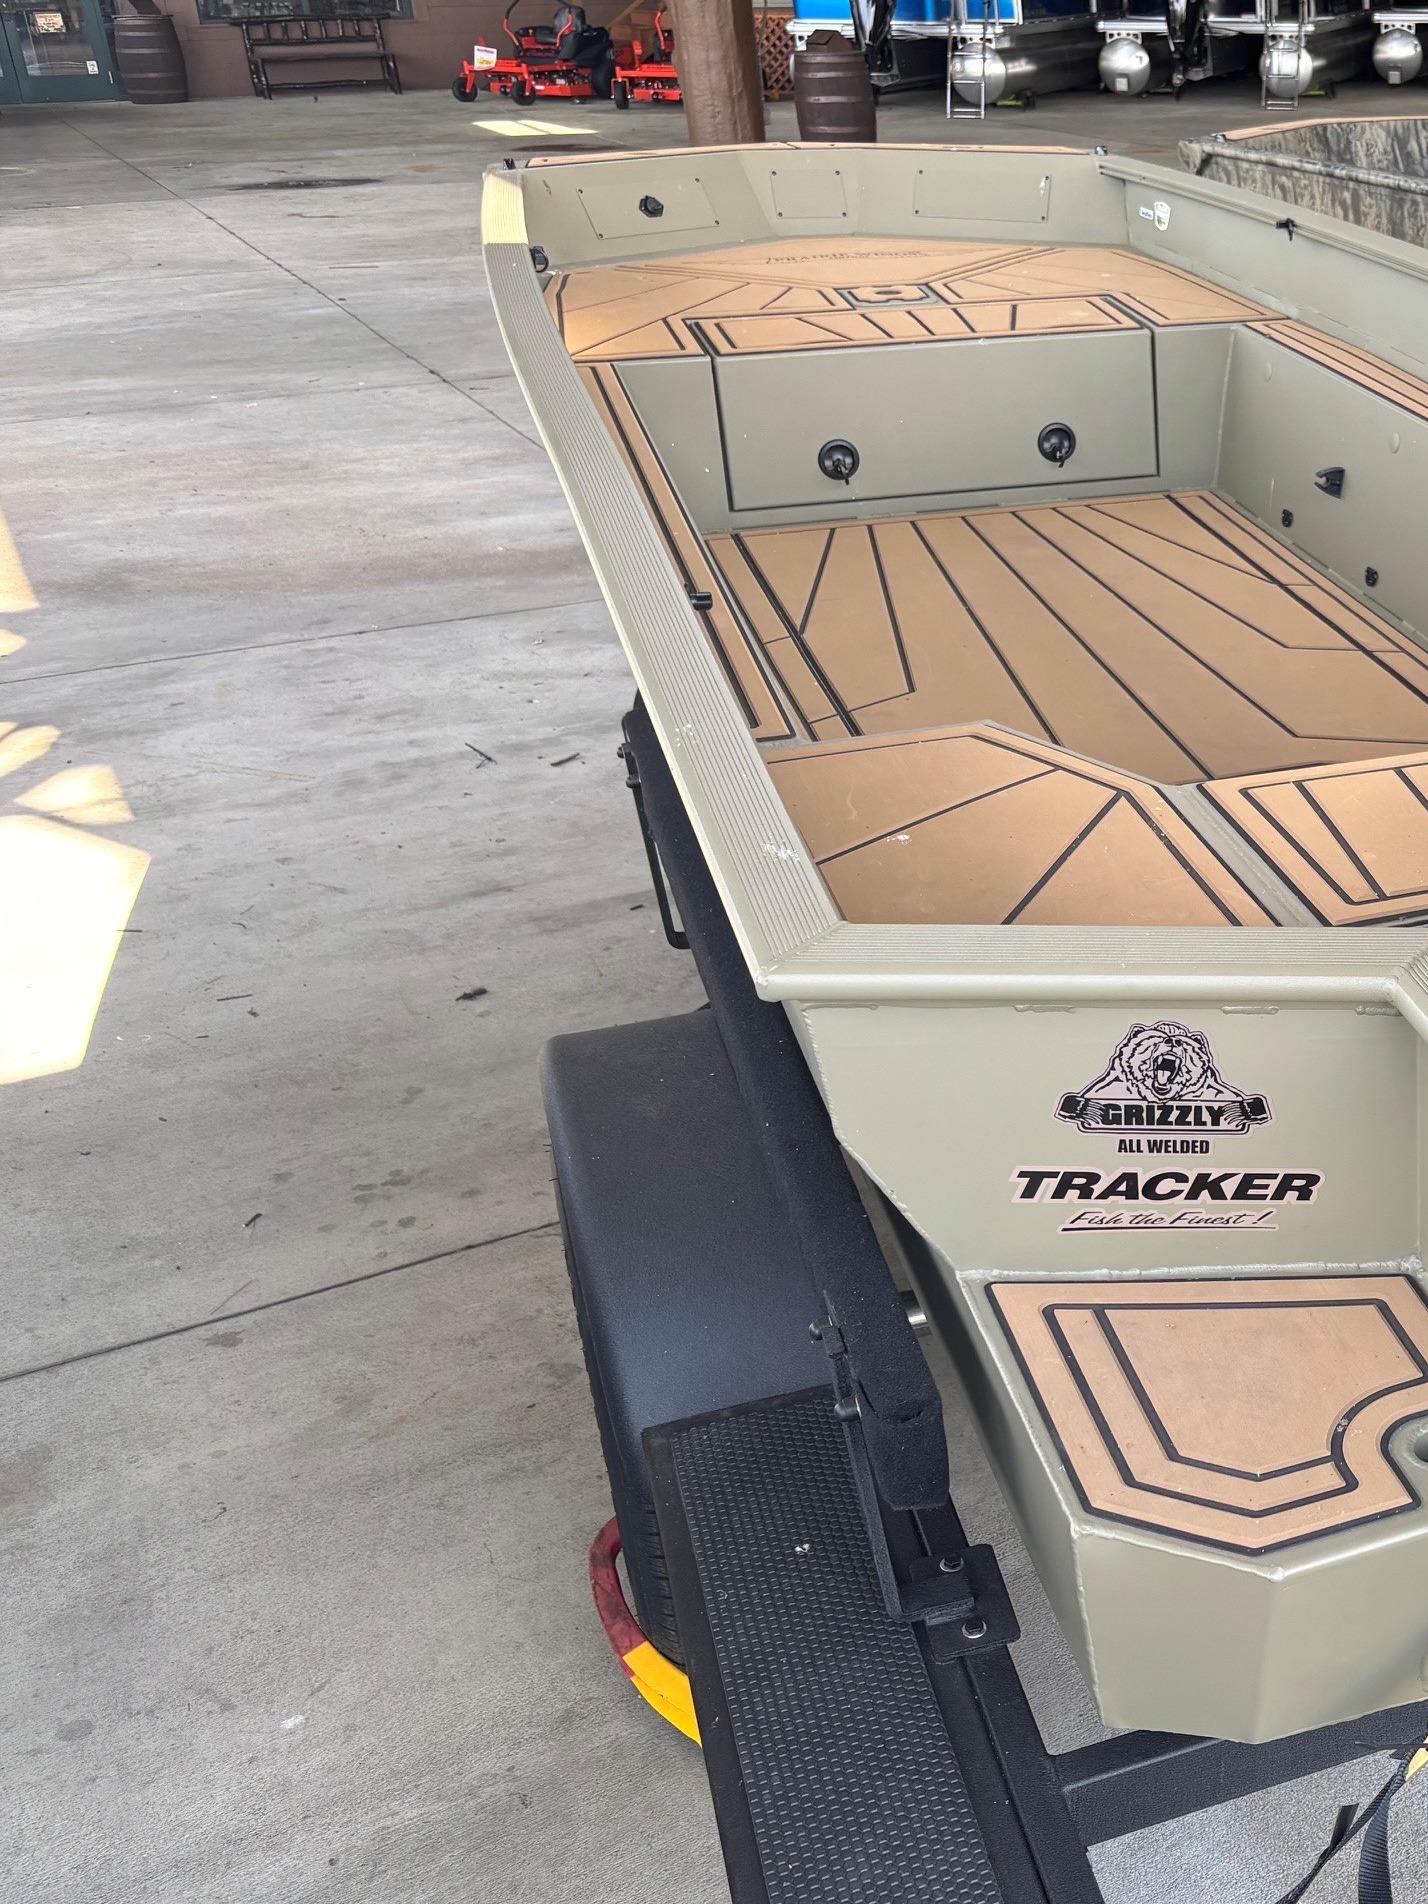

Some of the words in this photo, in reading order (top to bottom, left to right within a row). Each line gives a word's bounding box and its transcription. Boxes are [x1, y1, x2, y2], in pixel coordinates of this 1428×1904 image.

[1101, 1103, 1224, 1127] GRIZZLY
[1117, 1138, 1145, 1154] ALL
[1147, 1139, 1210, 1155] WELDED
[1016, 1170, 1321, 1201] TRACKER
[1069, 1210, 1126, 1226] Fish
[1127, 1212, 1165, 1225] the
